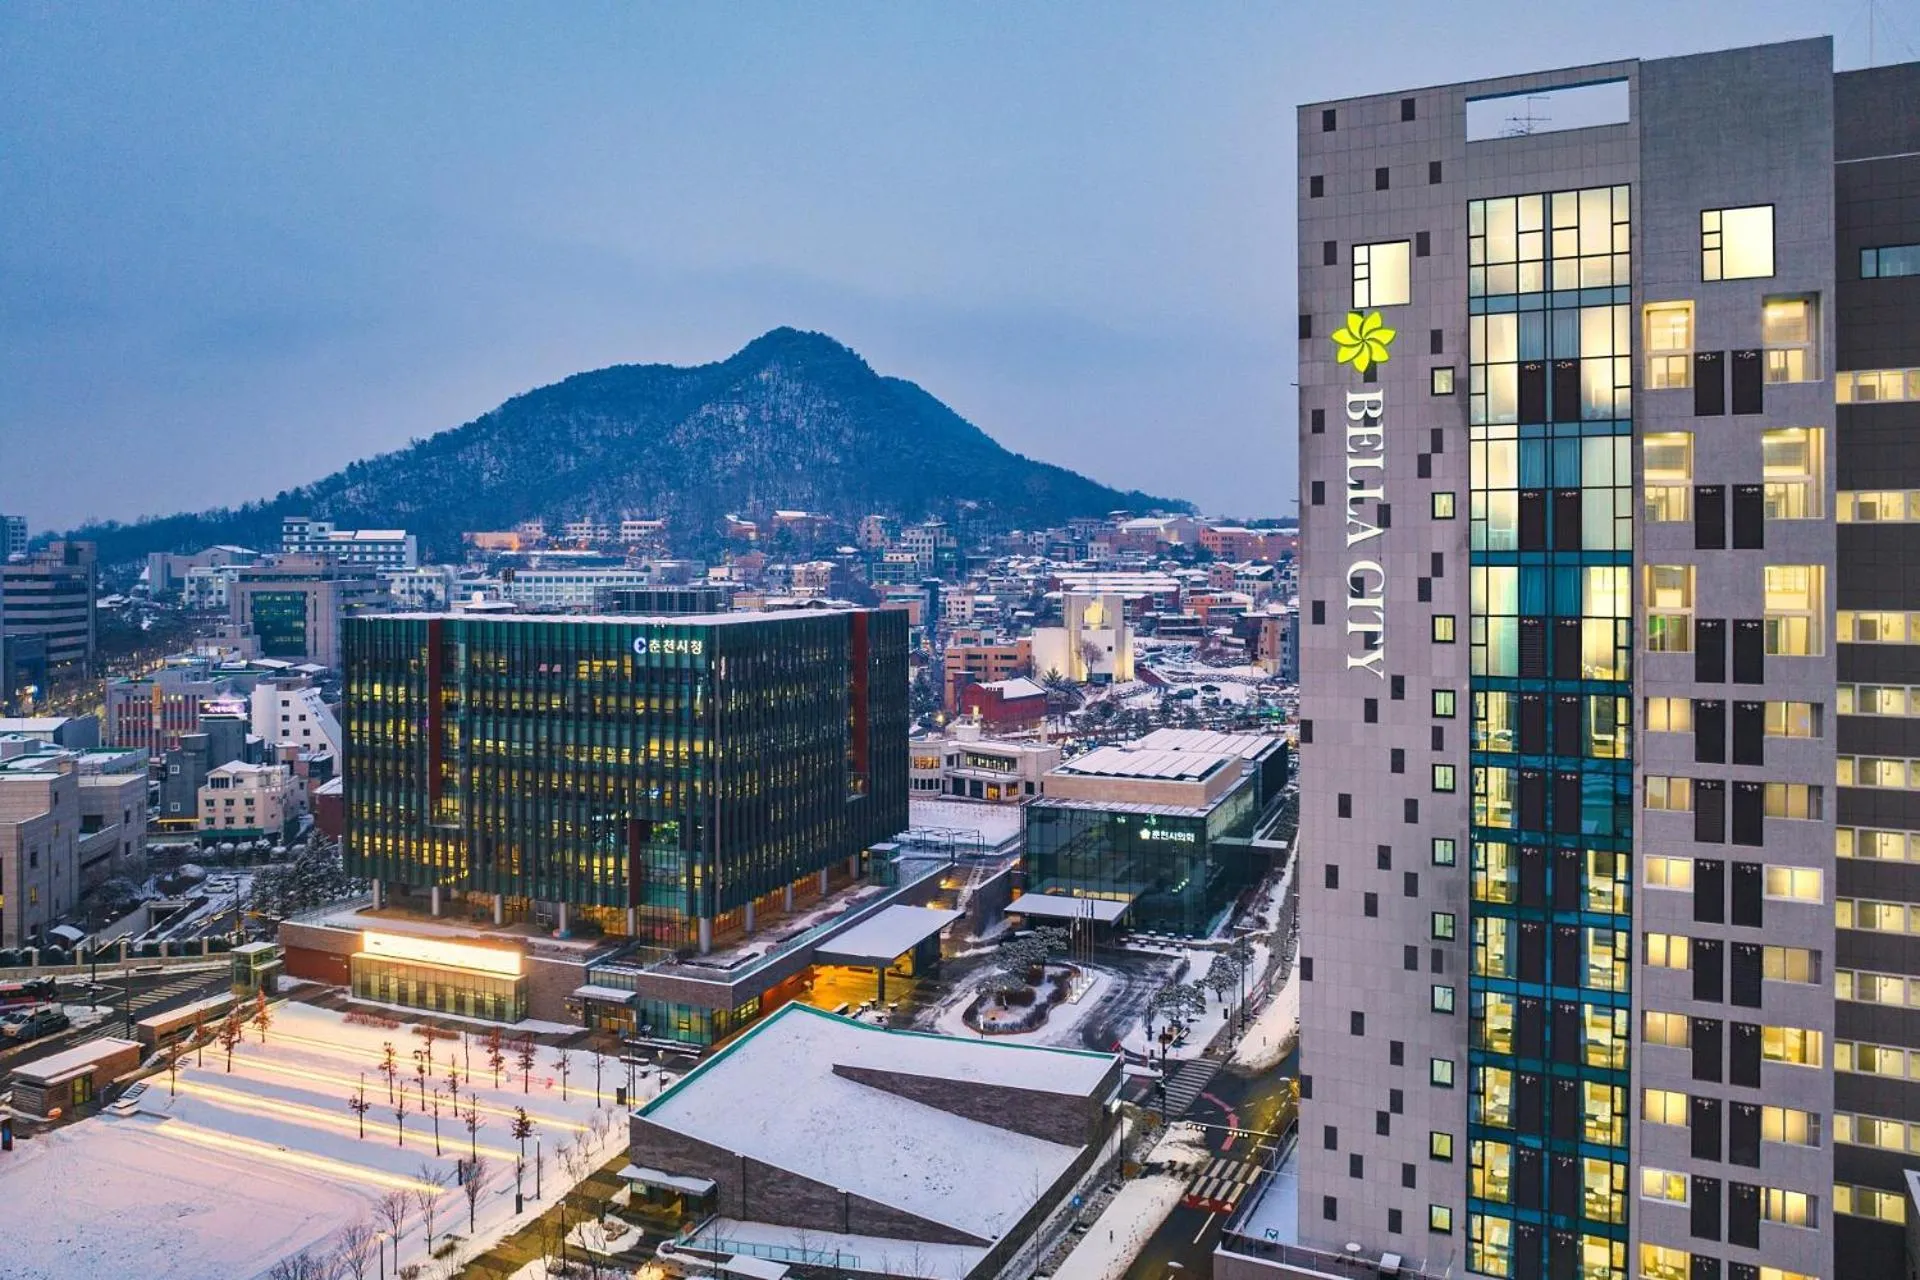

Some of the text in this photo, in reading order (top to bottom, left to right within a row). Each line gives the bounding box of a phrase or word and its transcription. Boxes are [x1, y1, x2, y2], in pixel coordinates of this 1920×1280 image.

[1346, 389, 1385, 680] BELLA CITY
[649, 639, 703, 654] 춘천시청
